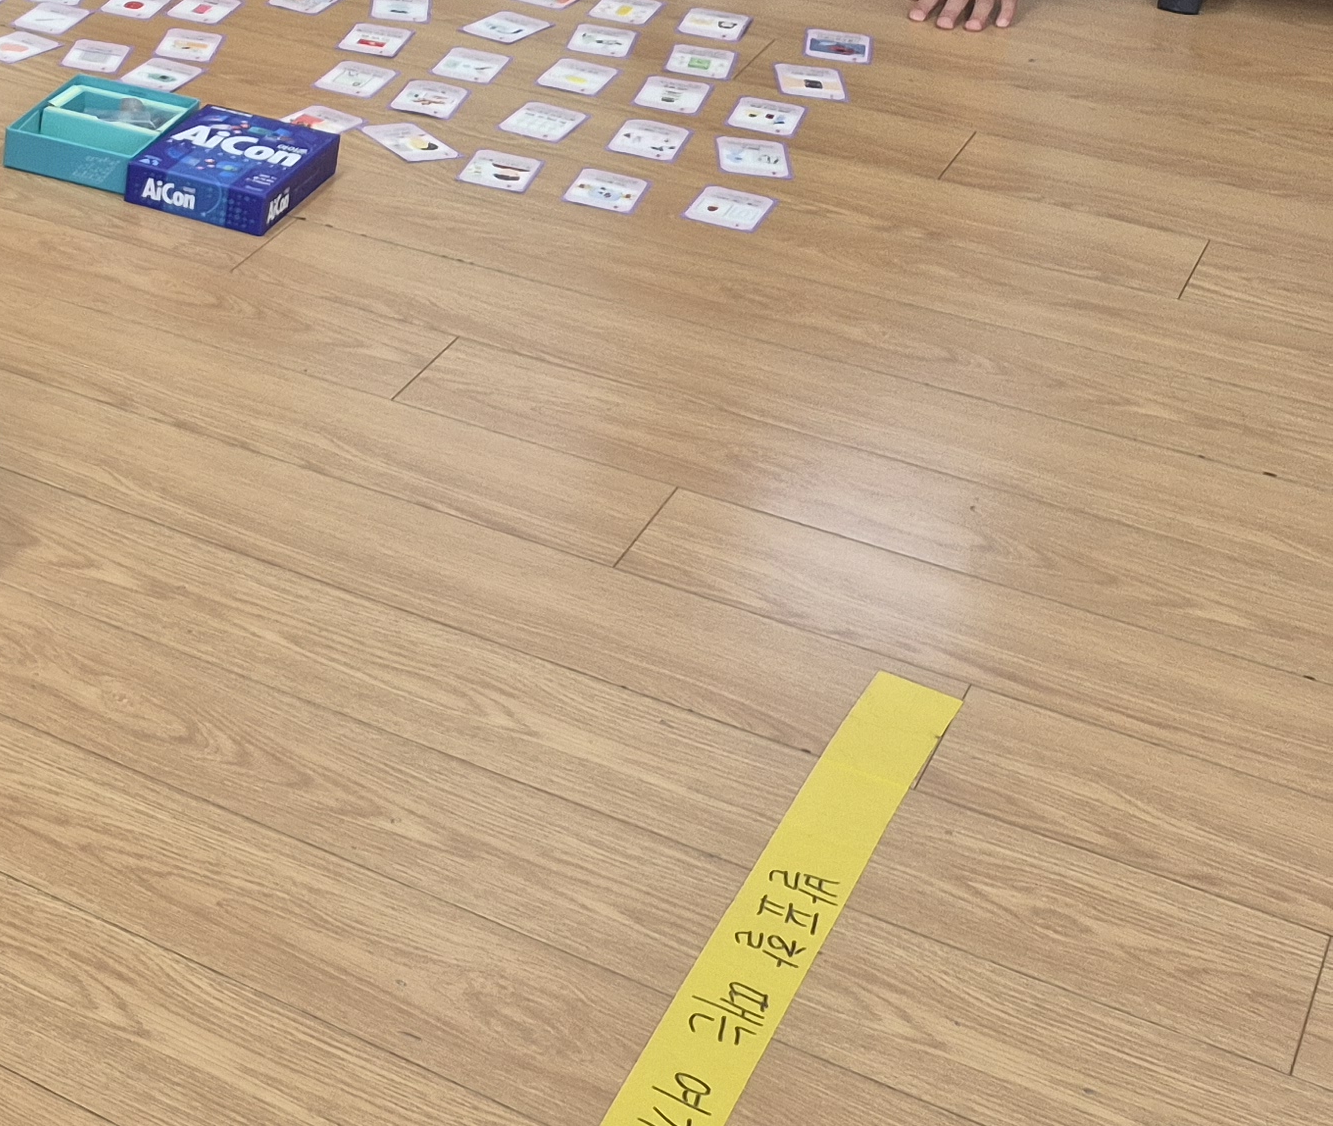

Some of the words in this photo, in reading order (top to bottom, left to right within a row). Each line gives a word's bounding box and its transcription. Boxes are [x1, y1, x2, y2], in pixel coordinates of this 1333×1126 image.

[171, 124, 303, 168] AiCon
[141, 177, 196, 211] AiCon
[265, 192, 291, 225] AiCon
[734, 869, 841, 969] 발표할
[688, 981, 770, 1046] 때는
